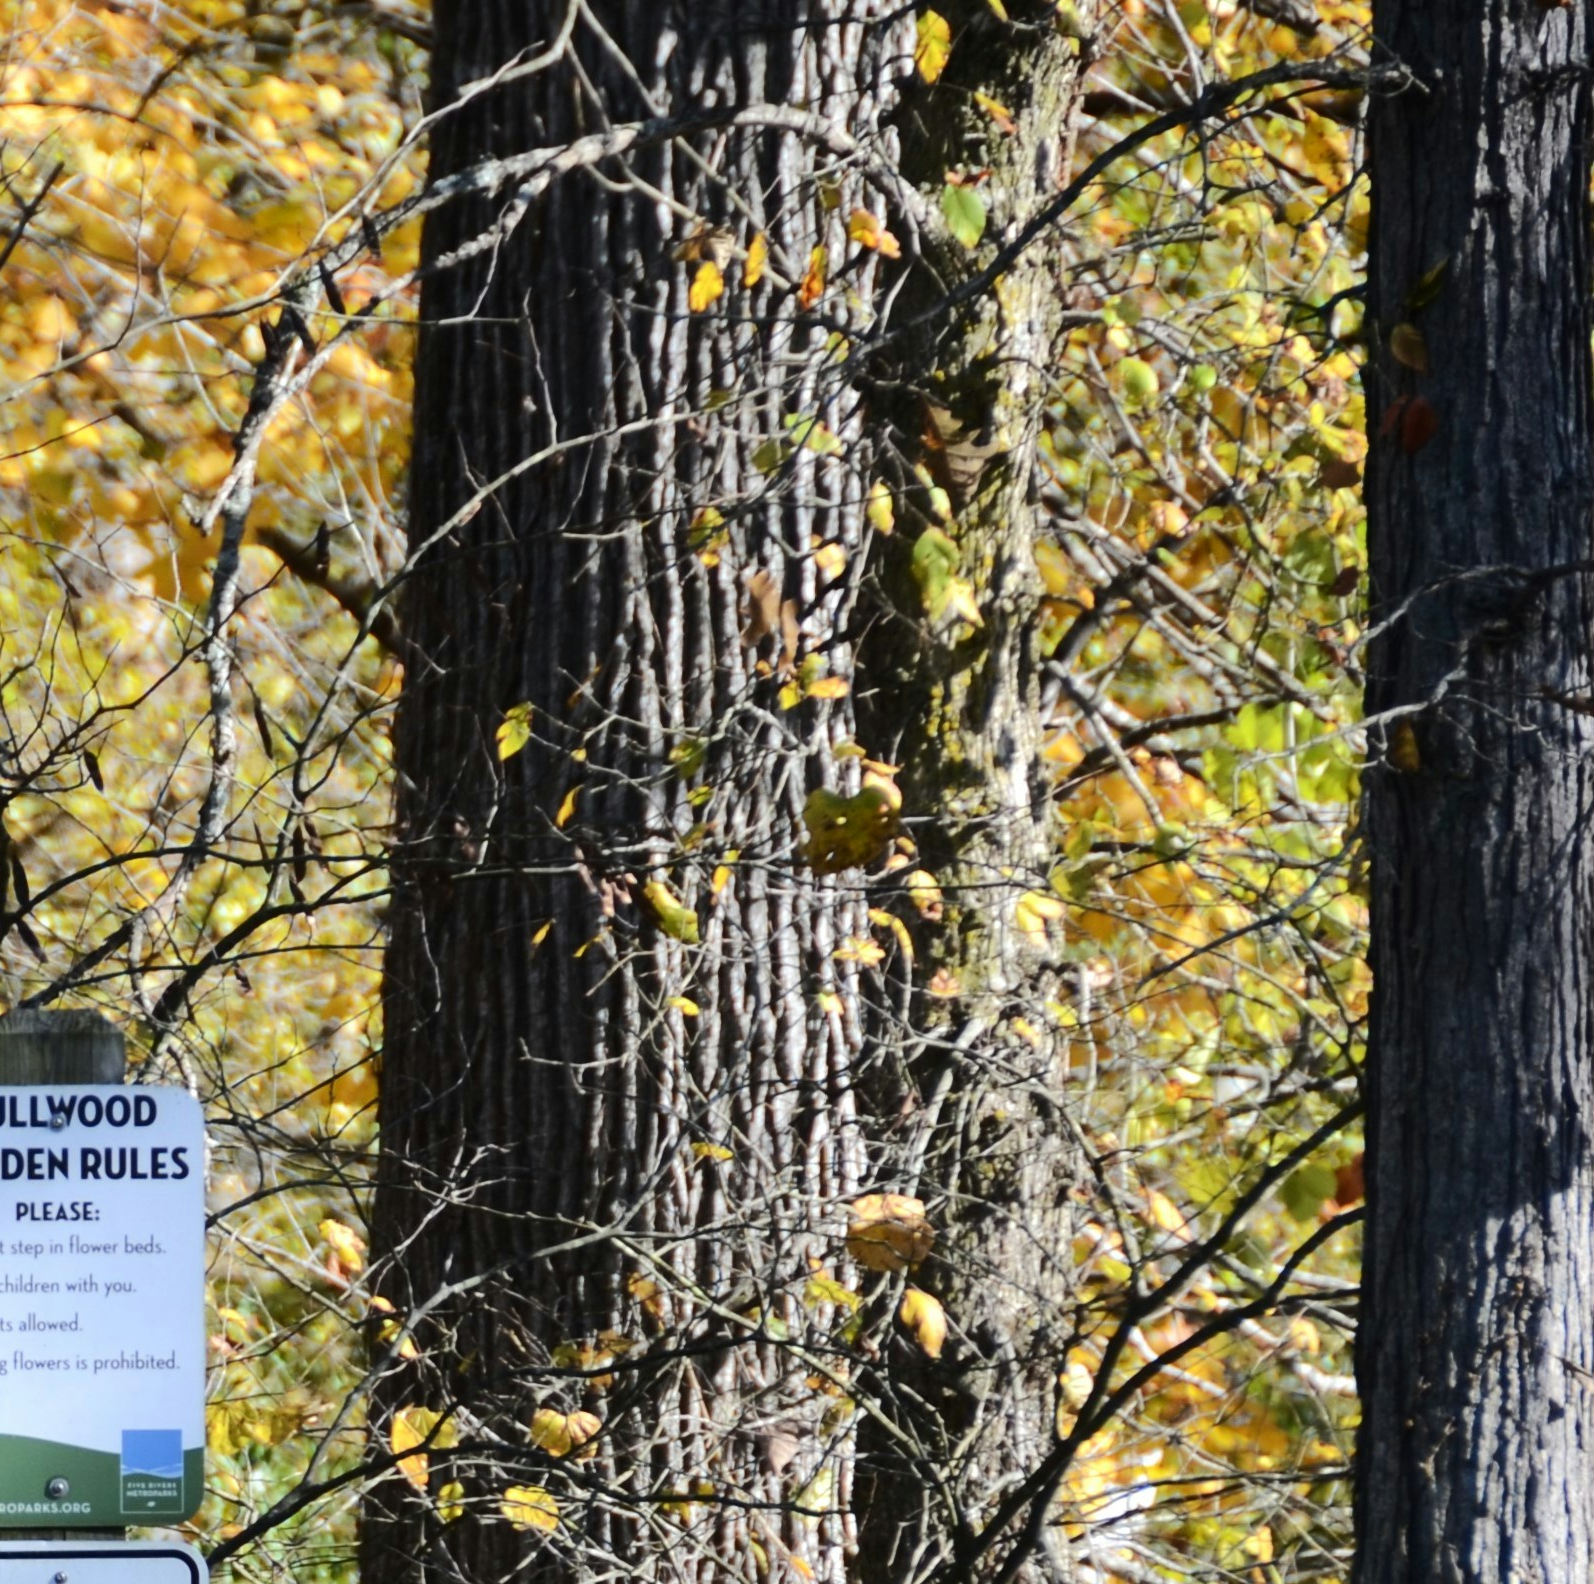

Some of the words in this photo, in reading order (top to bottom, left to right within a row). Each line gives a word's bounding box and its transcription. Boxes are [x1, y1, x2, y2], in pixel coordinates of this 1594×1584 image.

[80, 1147, 189, 1181] RULES
[15, 1202, 100, 1221] PLEASE:
[11, 1239, 44, 1258] step
[50, 1237, 63, 1254] in
[69, 1234, 118, 1254] flower
[124, 1234, 167, 1254] beds.
[66, 1274, 98, 1293] with
[105, 1281, 136, 1297] you.
[19, 1313, 83, 1332] allowed.
[13, 1351, 70, 1371] flowers
[76, 1355, 88, 1370] is
[94, 1351, 180, 1374] prohibited.
